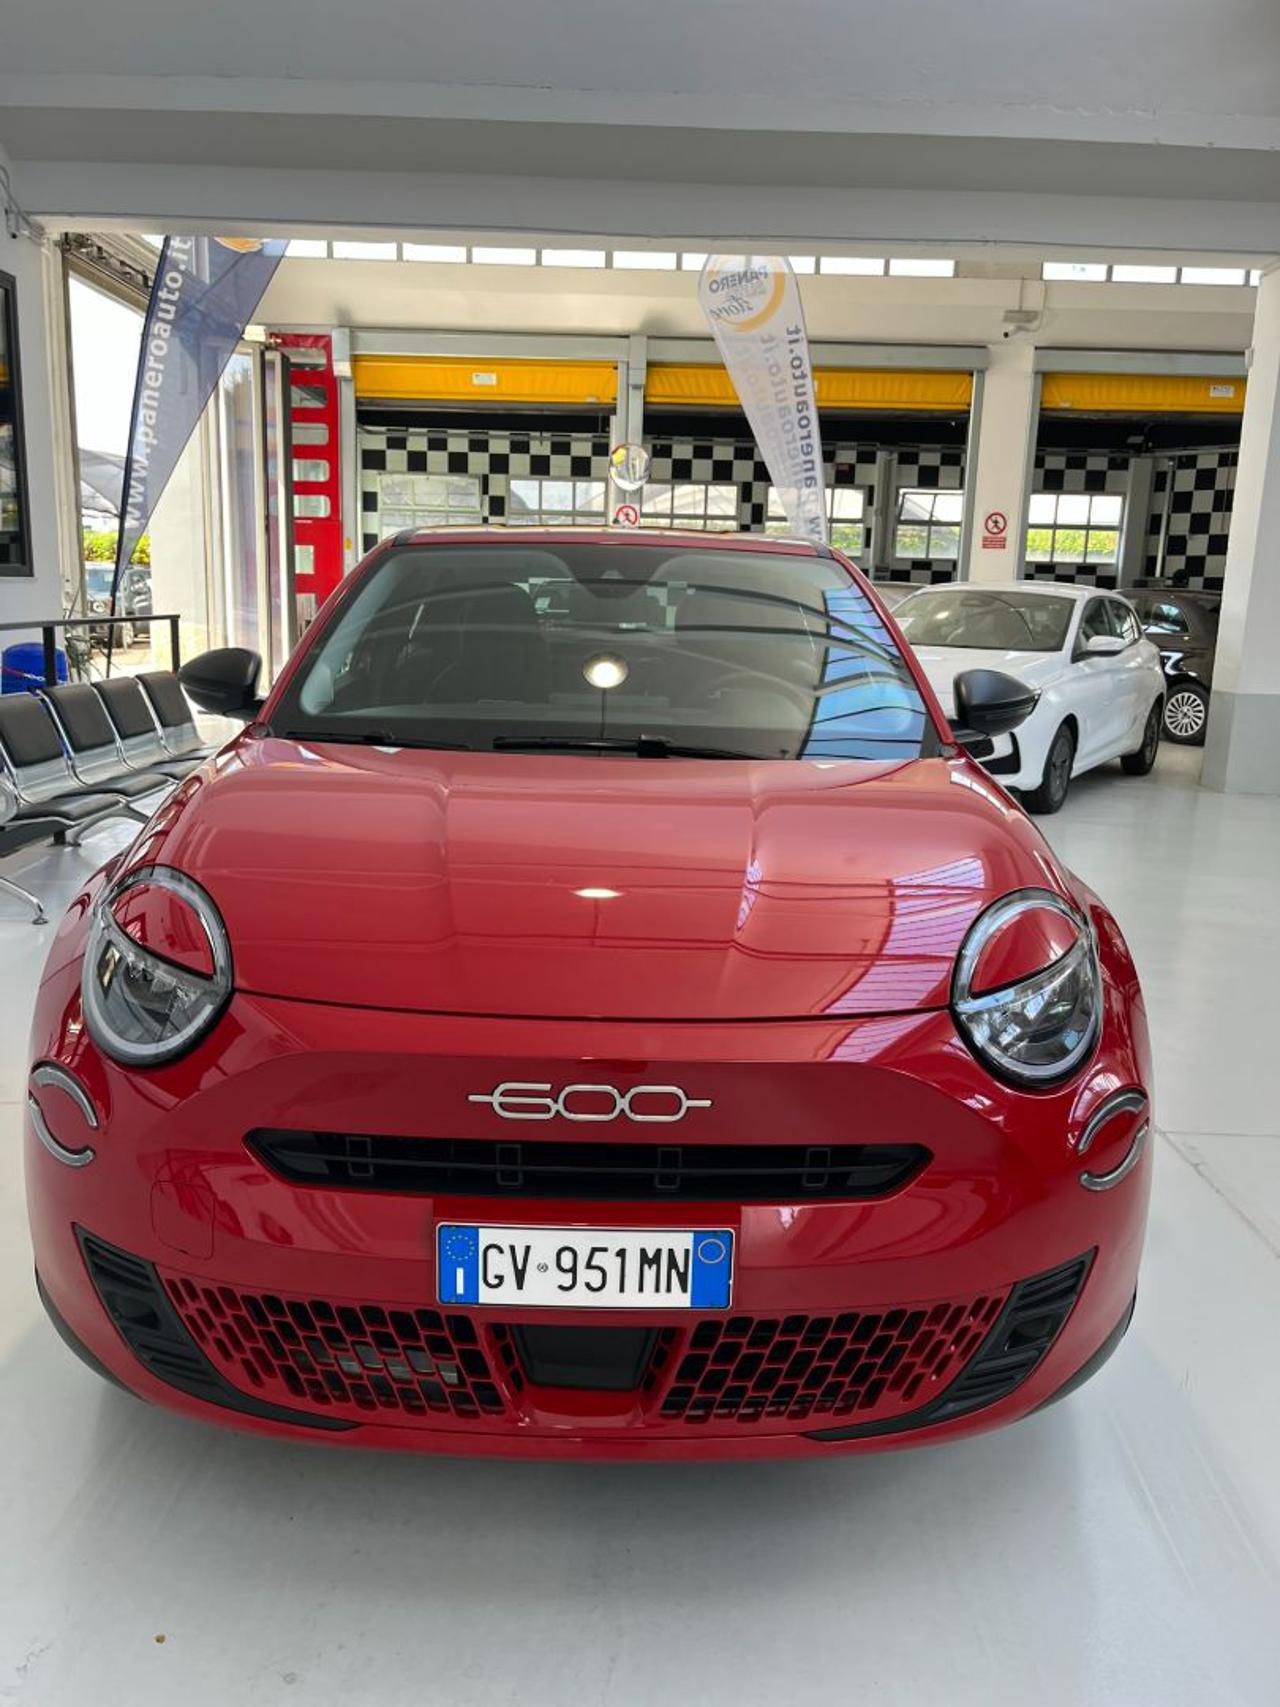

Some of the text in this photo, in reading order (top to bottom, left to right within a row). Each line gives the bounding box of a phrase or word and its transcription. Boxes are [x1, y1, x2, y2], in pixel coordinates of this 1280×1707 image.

[124, 236, 191, 528] www.paneroauto.it
[468, 1082, 712, 1122] 600
[482, 1243, 690, 1294] GV 951MN
